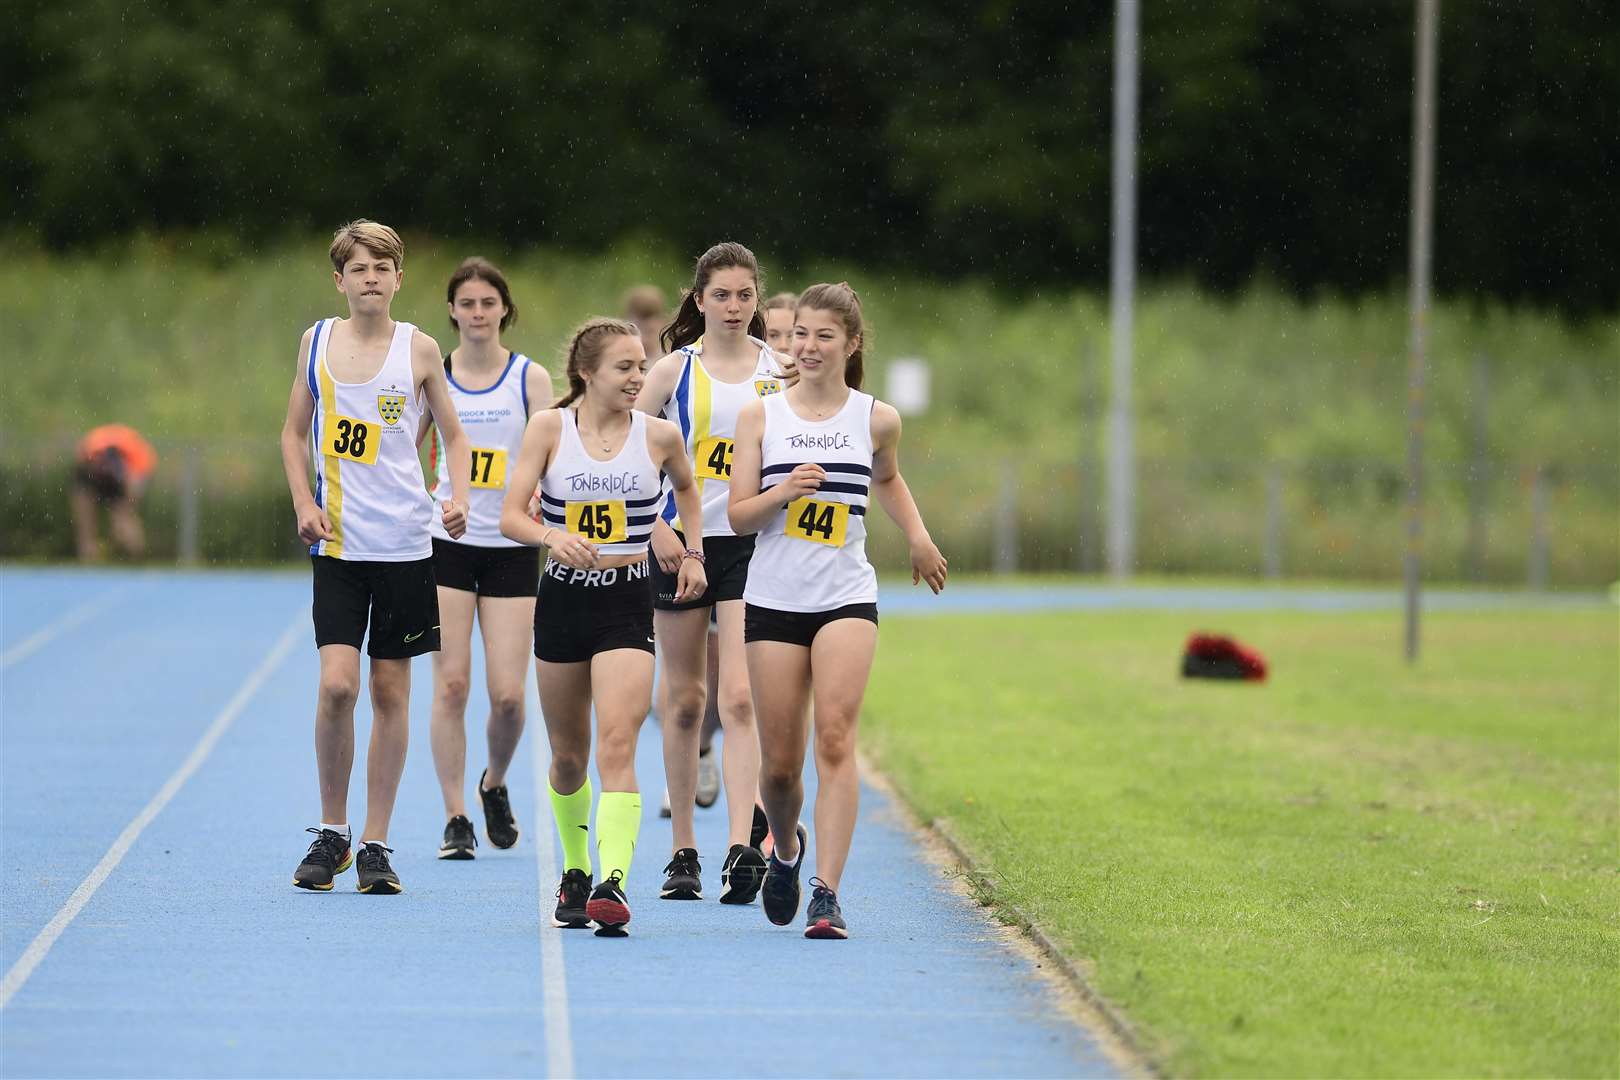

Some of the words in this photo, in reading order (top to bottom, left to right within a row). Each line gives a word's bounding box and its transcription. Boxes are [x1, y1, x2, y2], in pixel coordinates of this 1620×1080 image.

[334, 419, 367, 457] 38
[578, 503, 612, 539] 45
[797, 502, 835, 539] 44
[569, 568, 618, 587] PRO
